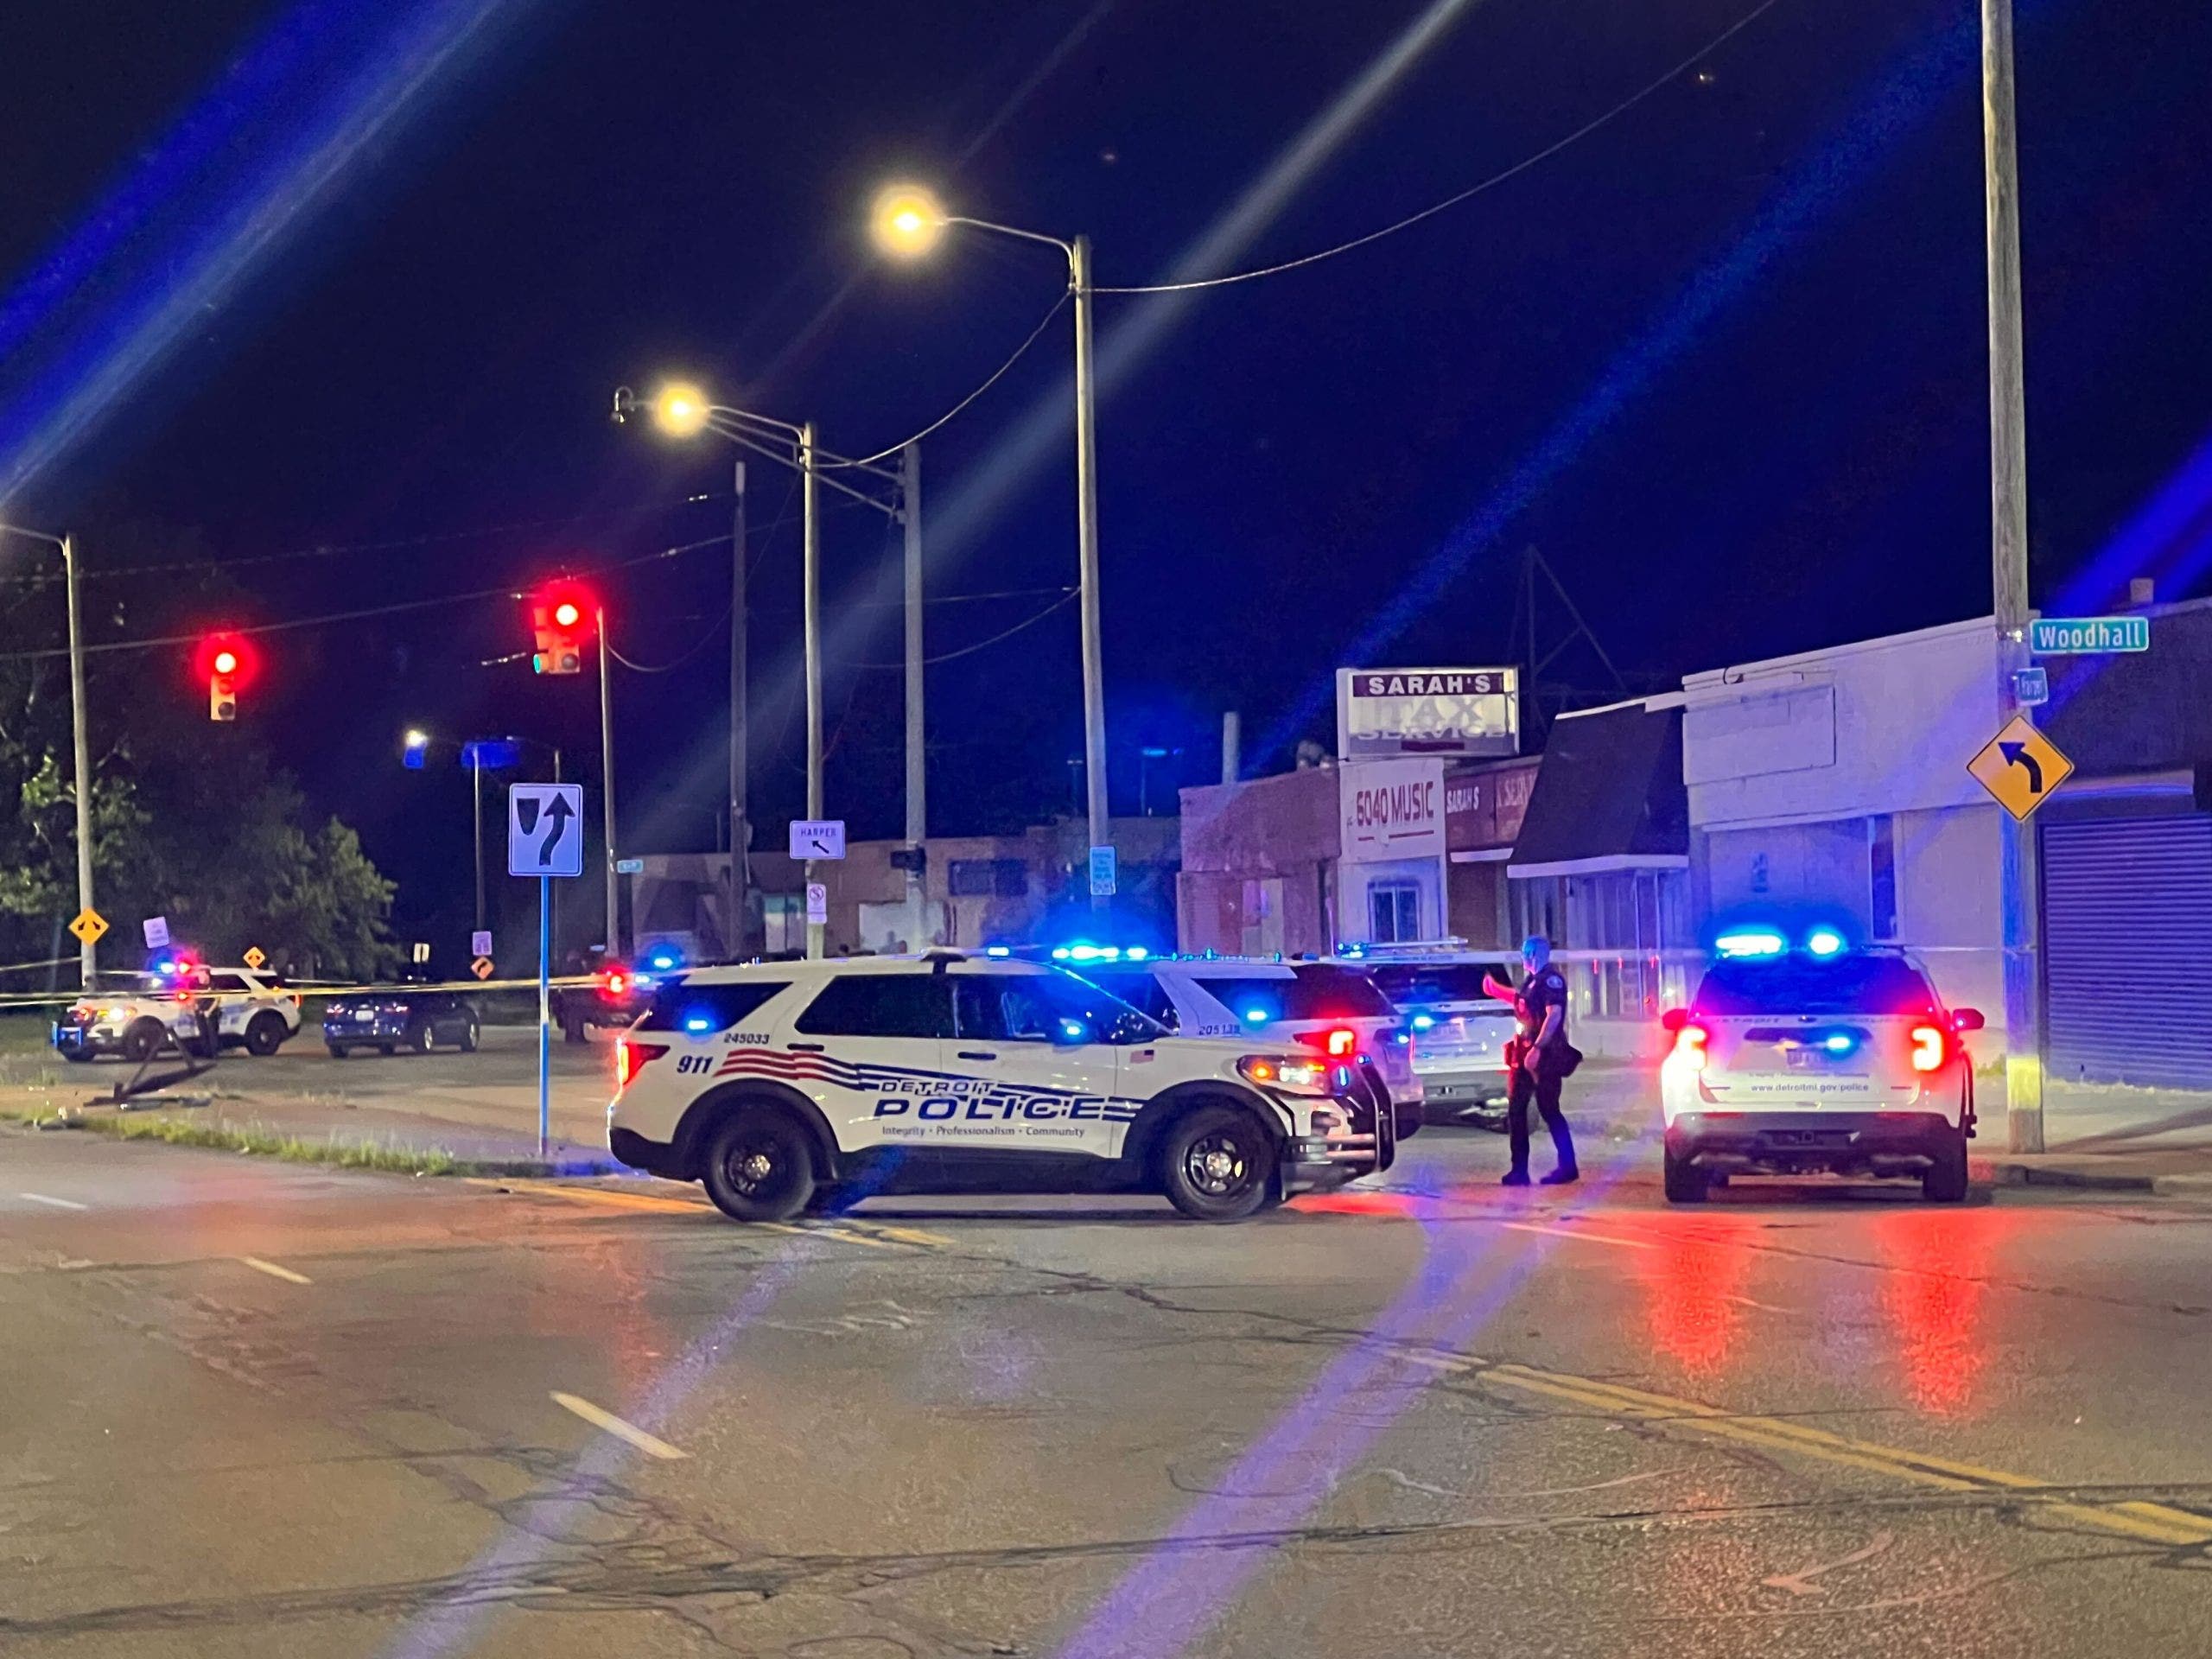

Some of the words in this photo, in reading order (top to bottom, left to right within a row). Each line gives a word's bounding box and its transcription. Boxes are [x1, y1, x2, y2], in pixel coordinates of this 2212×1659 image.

[2039, 622, 2140, 648] Woodhall
[1369, 675, 1491, 695] SARAH'S
[1357, 788, 1389, 826] 6040
[1391, 781, 1433, 823] MUSIC
[800, 828, 836, 837] HARPER
[724, 1033, 770, 1045] 245033
[677, 1055, 714, 1074] 911
[881, 1082, 995, 1096] DETROIT
[874, 1097, 1104, 1120] POLICE
[882, 1126, 925, 1138] Integrity
[936, 1126, 1015, 1136] Professionalism
[1026, 1126, 1085, 1138] Community
